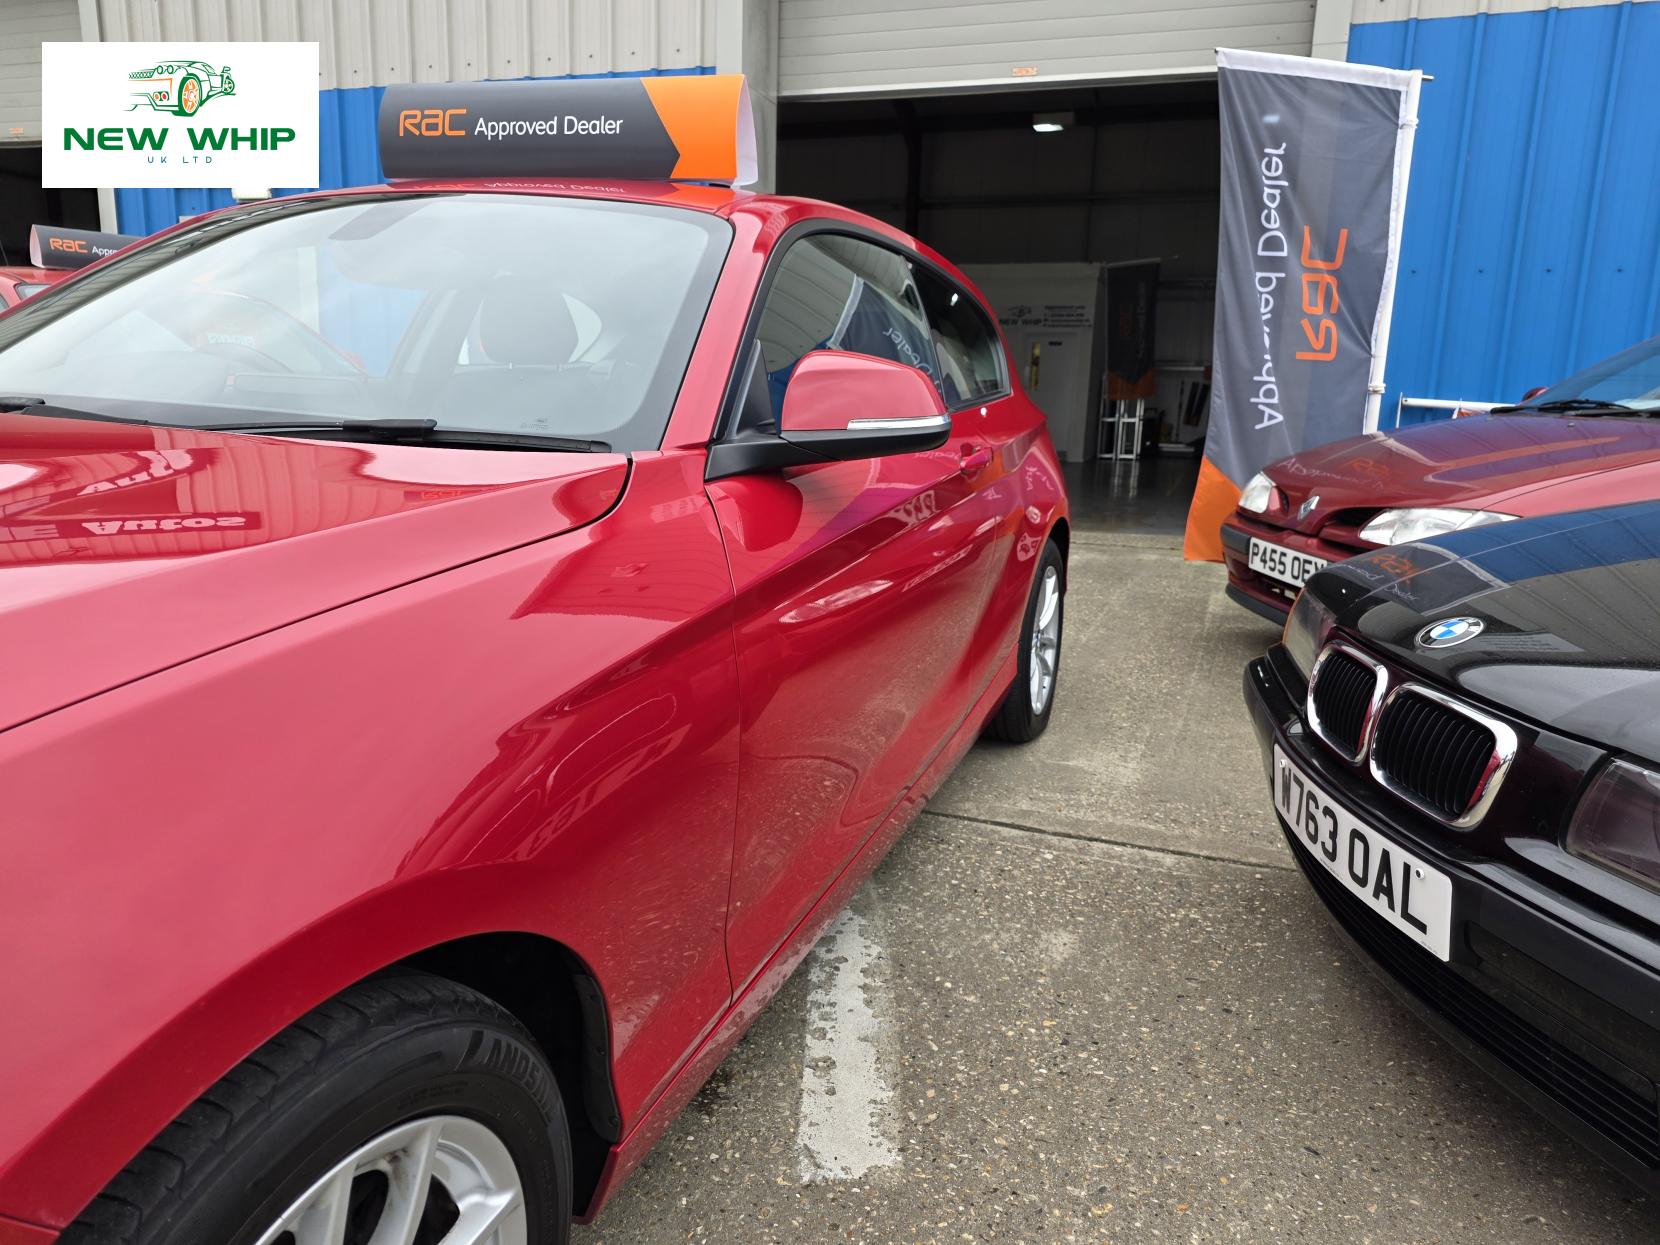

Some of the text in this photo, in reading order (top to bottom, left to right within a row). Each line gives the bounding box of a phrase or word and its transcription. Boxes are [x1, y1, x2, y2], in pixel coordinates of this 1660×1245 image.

[474, 116, 558, 140] Approved
[563, 115, 624, 136] Dealer
[1250, 542, 1287, 576] P455
[1281, 766, 1428, 936] W763 OAL
